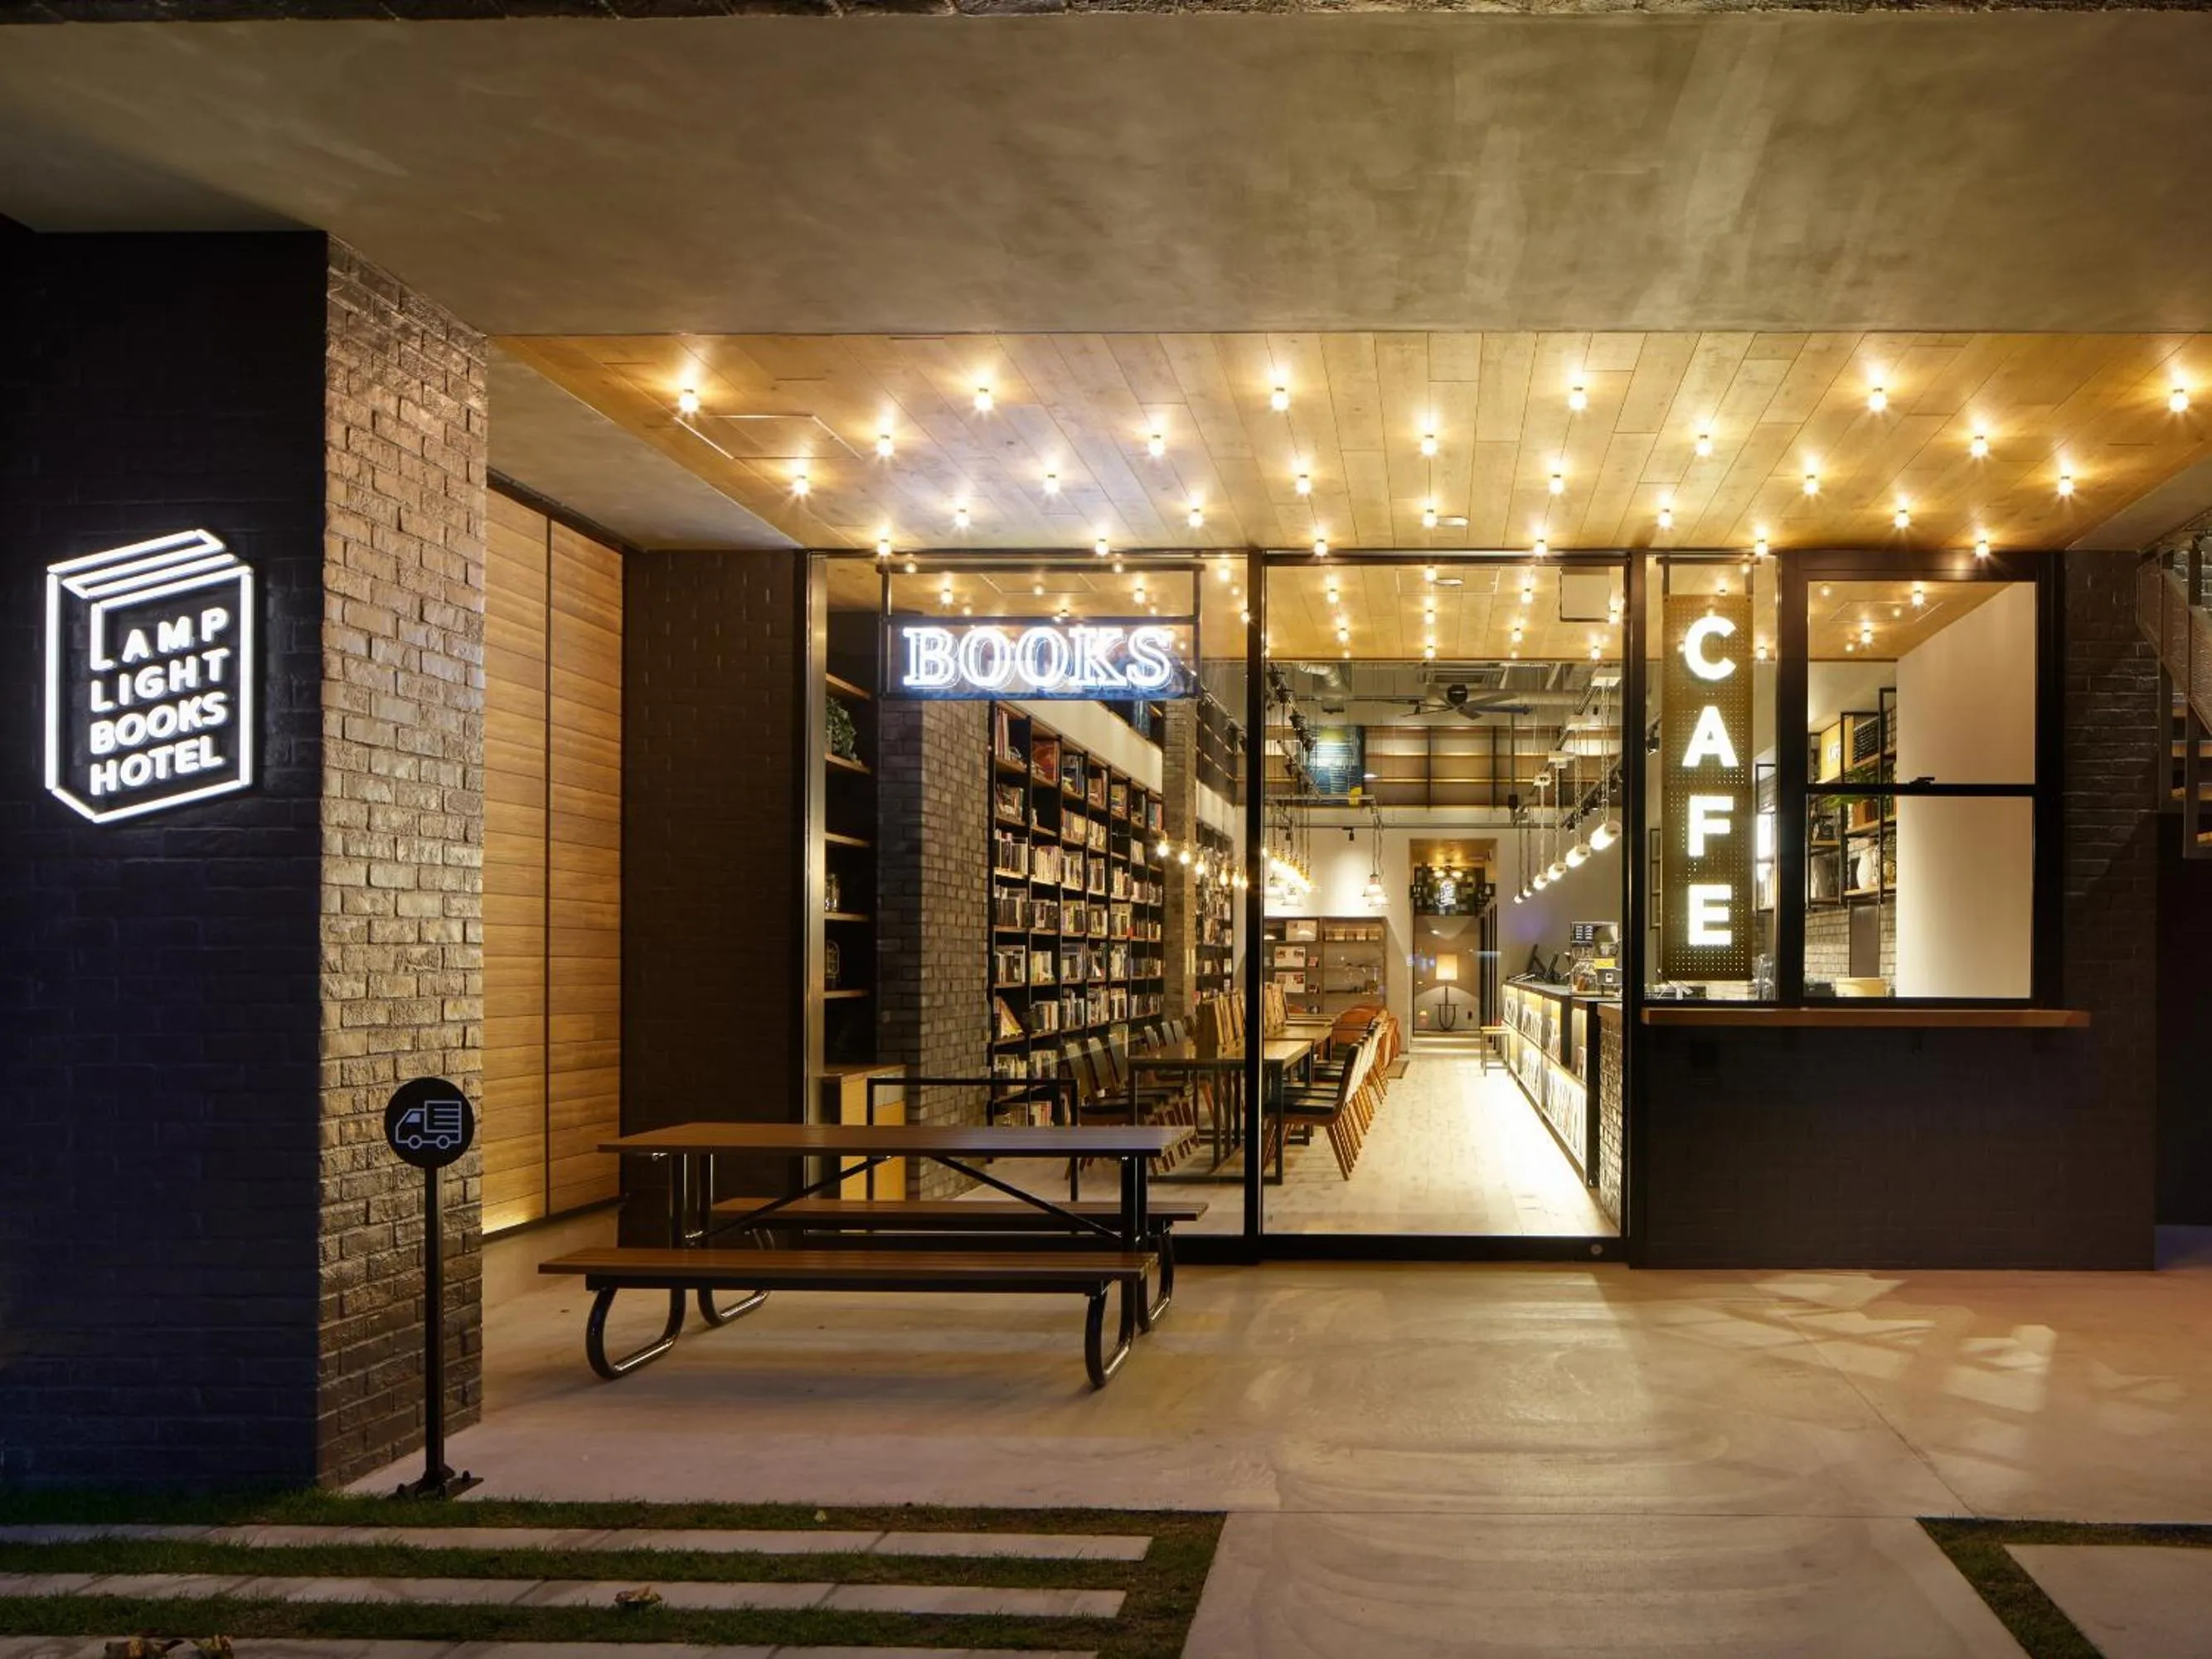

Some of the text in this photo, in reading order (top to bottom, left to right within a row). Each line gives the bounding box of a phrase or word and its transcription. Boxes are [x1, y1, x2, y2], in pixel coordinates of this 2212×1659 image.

[90, 604, 230, 671] LAMP
[902, 626, 1174, 689] BOOKS
[90, 648, 230, 712] LIGHT
[90, 692, 228, 754] BOOKS
[90, 736, 225, 795] HOTEL
[1682, 615, 1739, 946] CAFE
